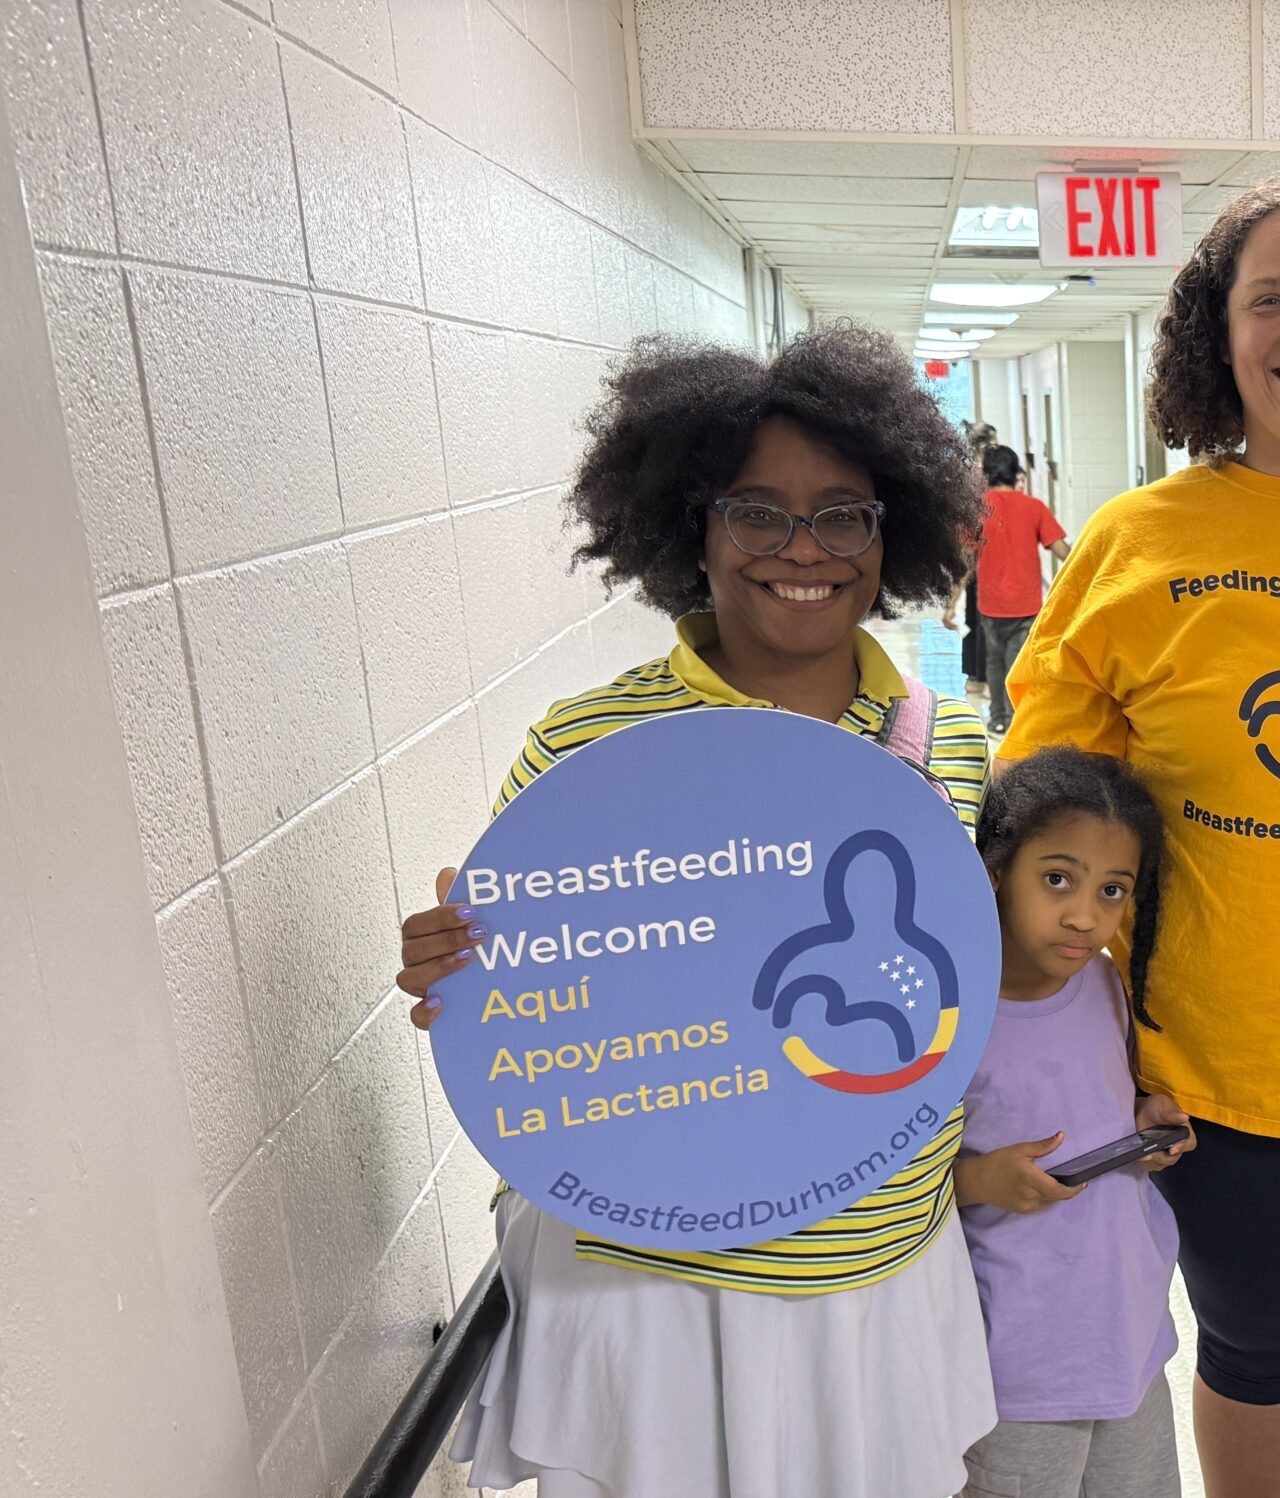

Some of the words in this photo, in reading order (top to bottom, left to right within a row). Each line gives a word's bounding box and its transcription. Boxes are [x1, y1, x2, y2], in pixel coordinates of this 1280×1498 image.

[1065, 176, 1161, 258] EXIT
[466, 838, 813, 906] Breastfeeding
[475, 916, 716, 971] Welcome
[481, 976, 590, 1024] Aquí
[488, 1020, 730, 1083] Apoyamos
[495, 1106, 547, 1138] La
[560, 1065, 770, 1126] Lactancia
[547, 1101, 940, 1233] BreastfeedDurham.org
